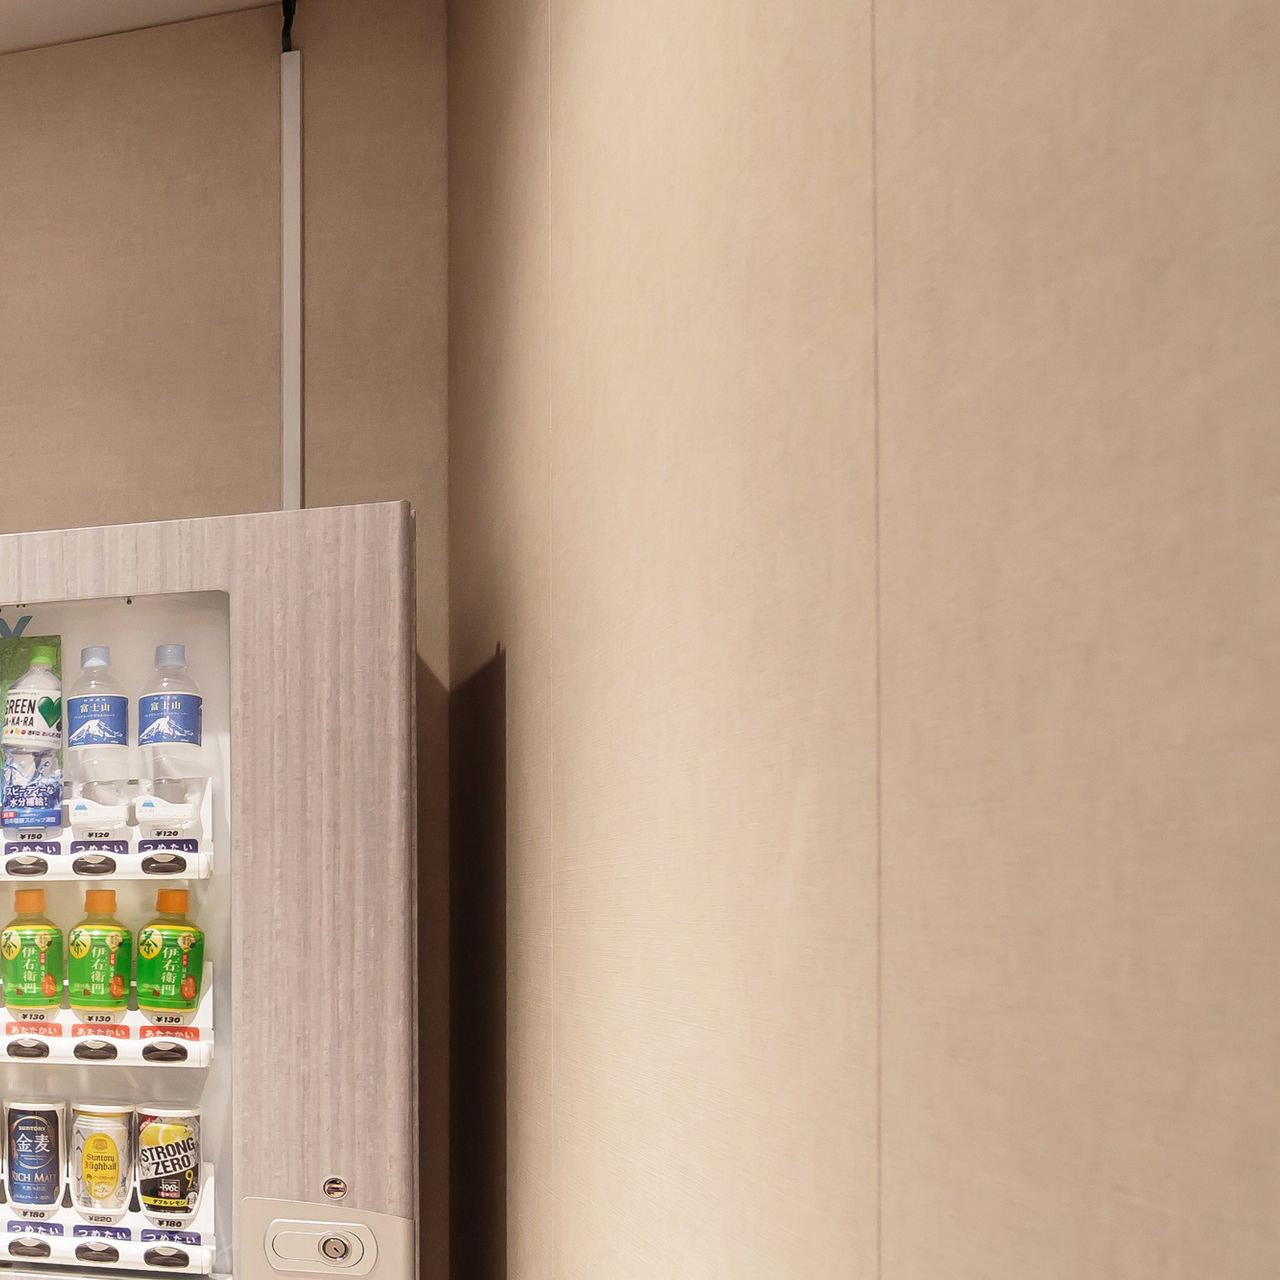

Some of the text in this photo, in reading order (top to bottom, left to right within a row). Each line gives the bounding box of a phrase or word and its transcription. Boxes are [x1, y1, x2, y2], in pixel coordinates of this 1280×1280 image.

[80, 702, 111, 714] 富士山
[150, 701, 182, 711] 富士山
[10, 846, 56, 854] つめたい
[76, 845, 124, 853] つめたい
[144, 843, 193, 851] つめたい
[3, 931, 18, 956] 茶
[70, 930, 86, 956] 茶
[139, 930, 158, 956] 茶
[22, 946, 38, 995] 伊右衛門
[90, 946, 107, 995] 伊右衛門
[160, 946, 179, 996] 伊右衛門
[21, 1013, 45, 1021] ¥130
[86, 1015, 111, 1023] ¥130
[155, 1016, 181, 1024] ¥130
[10, 1025, 58, 1035] あたたかい
[76, 1027, 125, 1037] あたたかい
[145, 1029, 194, 1040] あたたかい
[16, 1132, 51, 1153] 金麦
[140, 1137, 196, 1163] STRONG
[86, 1153, 115, 1163] Suntory
[84, 1160, 118, 1172] Highball
[152, 1154, 192, 1176] ZERO
[22, 1211, 45, 1219] ¥180
[89, 1215, 113, 1223] ¥220
[158, 1220, 182, 1229] ¥180
[12, 1225, 59, 1236] つめたい
[78, 1228, 127, 1240] つめたい
[146, 1233, 197, 1245] つめたい
